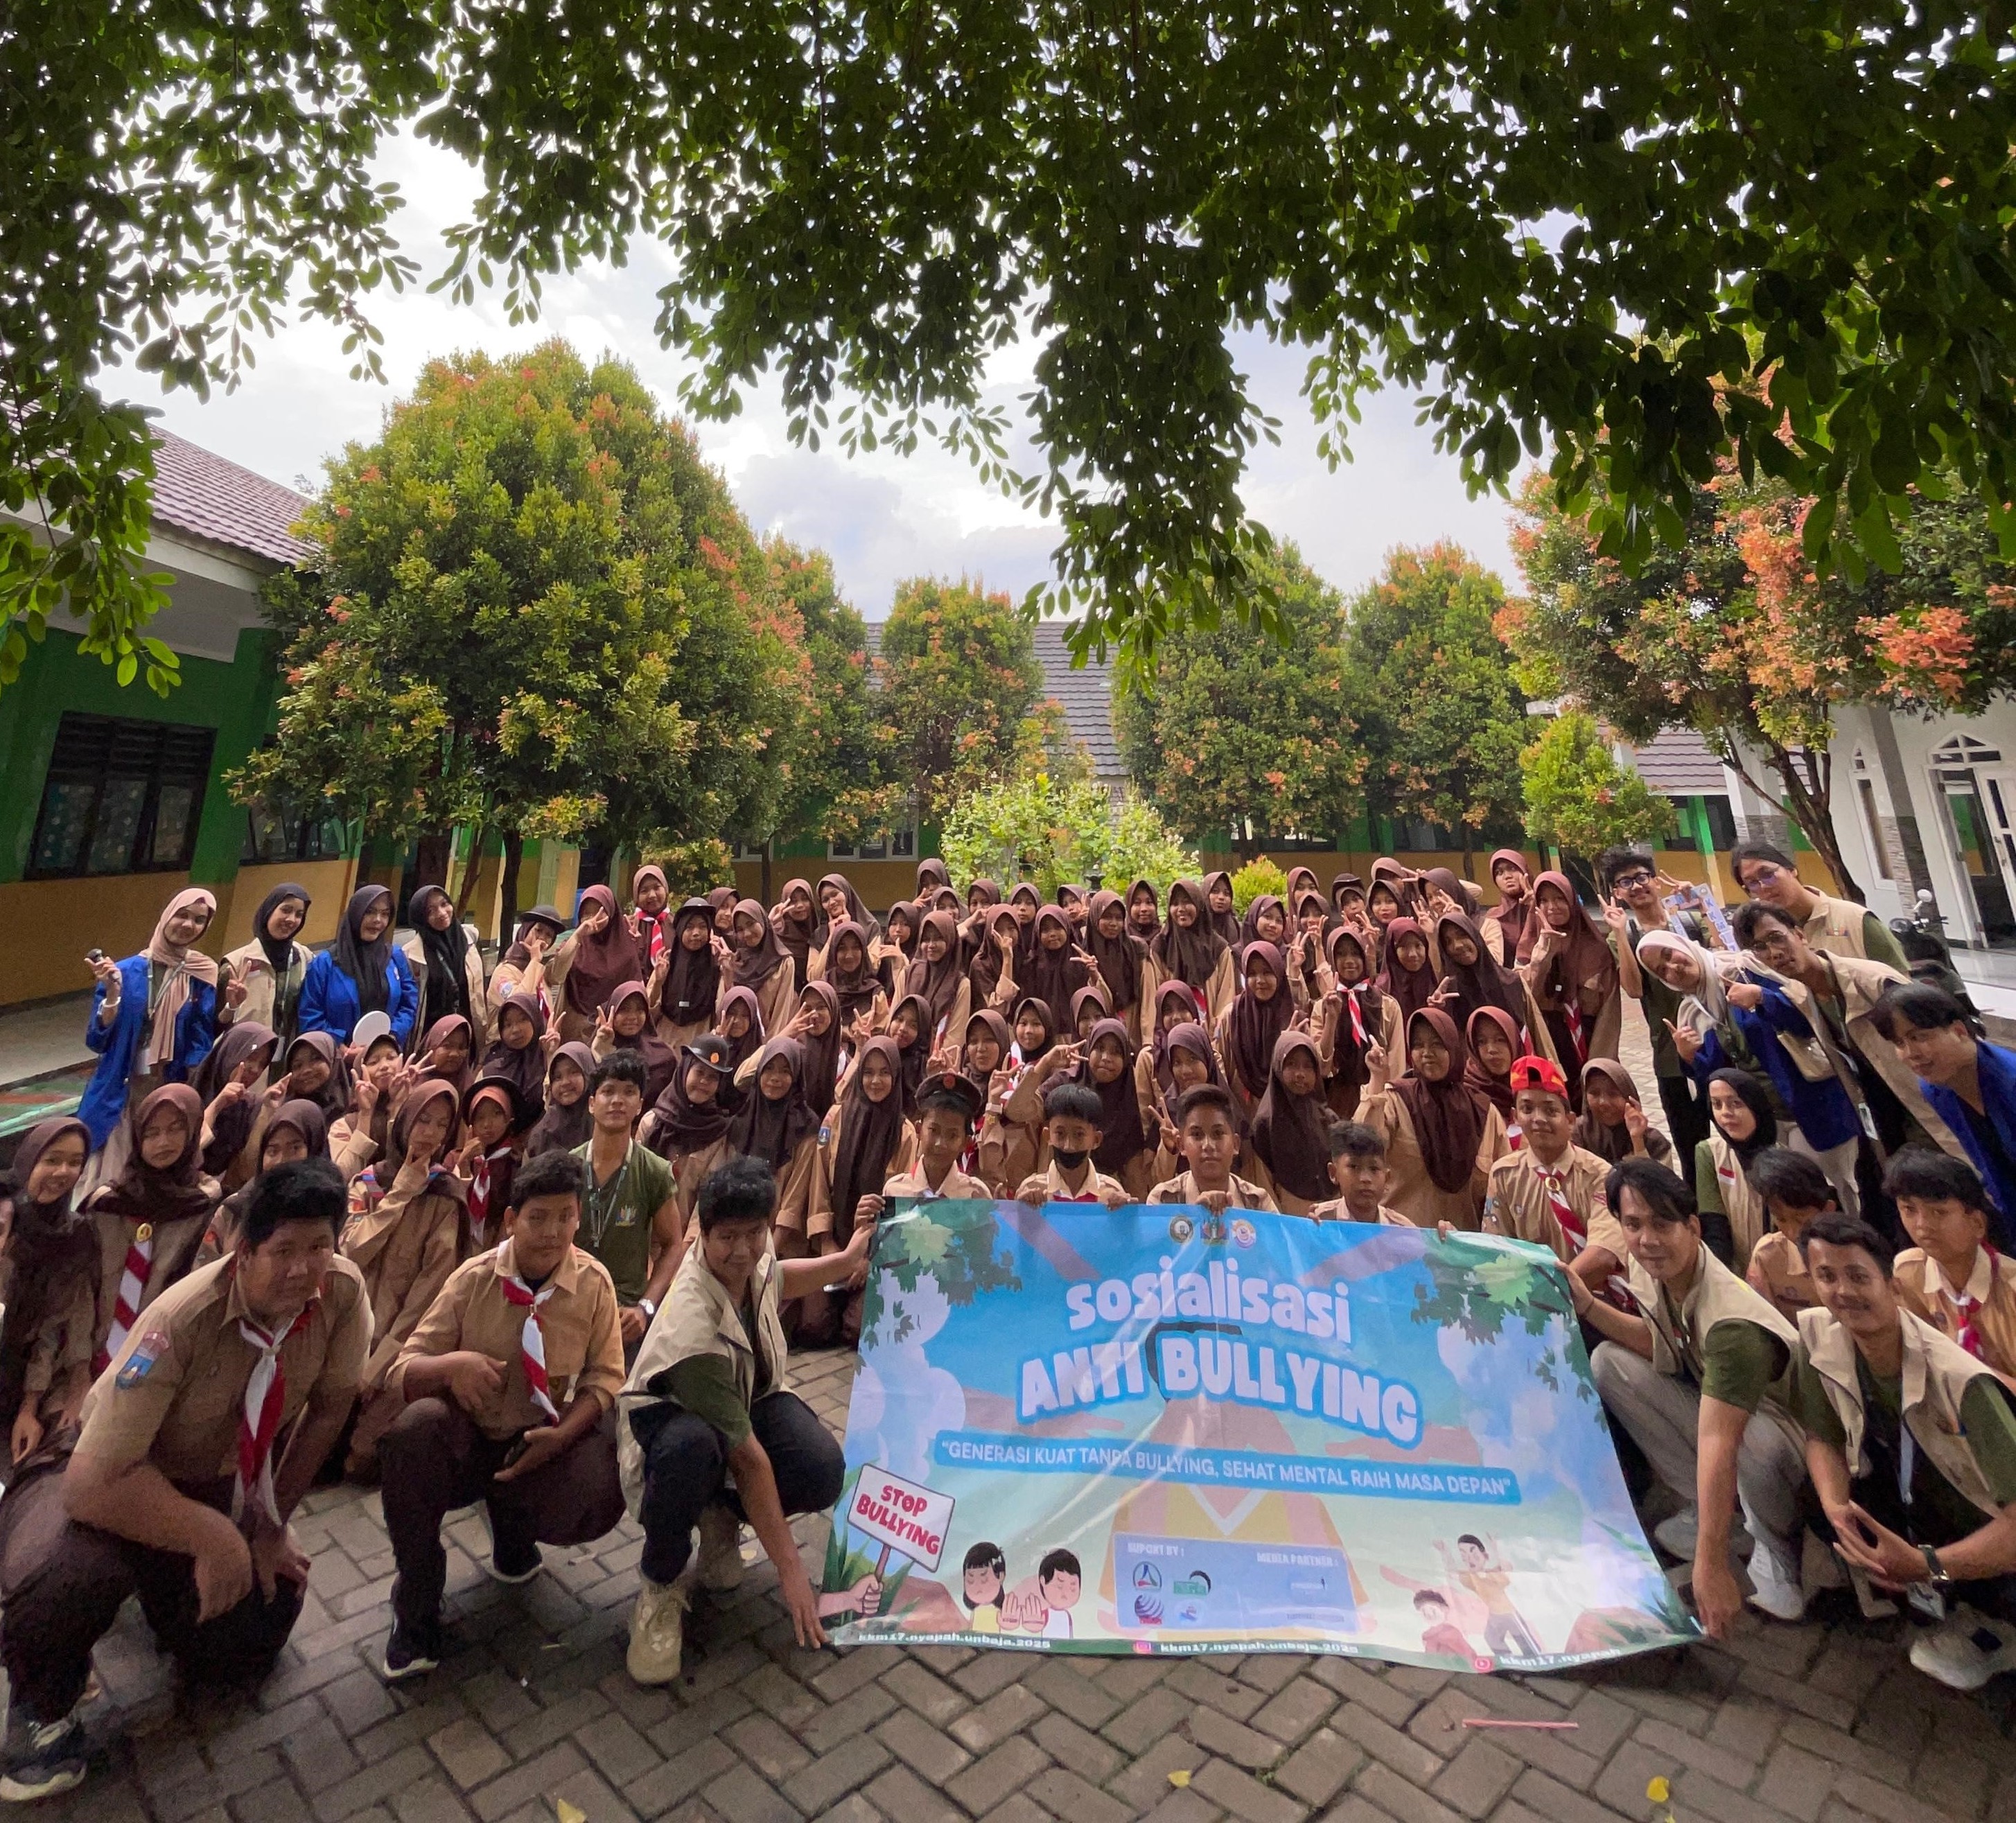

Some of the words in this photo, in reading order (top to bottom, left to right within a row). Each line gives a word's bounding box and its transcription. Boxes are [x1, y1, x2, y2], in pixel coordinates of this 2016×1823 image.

[1066, 1255, 1351, 1344] sosialisasi
[1021, 1341, 1146, 1418] ANTI
[1161, 1337, 1418, 1442] BULLYING
[1035, 1447, 1076, 1464] KUAT
[1079, 1447, 1132, 1468] TANPA
[1135, 1452, 1220, 1478] BULLYING,
[1222, 1461, 1276, 1480] SEHAT
[1279, 1464, 1348, 1486] MENTAL
[1351, 1469, 1391, 1489] RAIH
[1395, 1473, 1445, 1492] MASA
[856, 1493, 940, 1555] BULLYING
[881, 1485, 928, 1517] STOP
[1256, 1552, 1289, 1564] MEDIA
[1290, 1553, 1333, 1567] PARTNER
